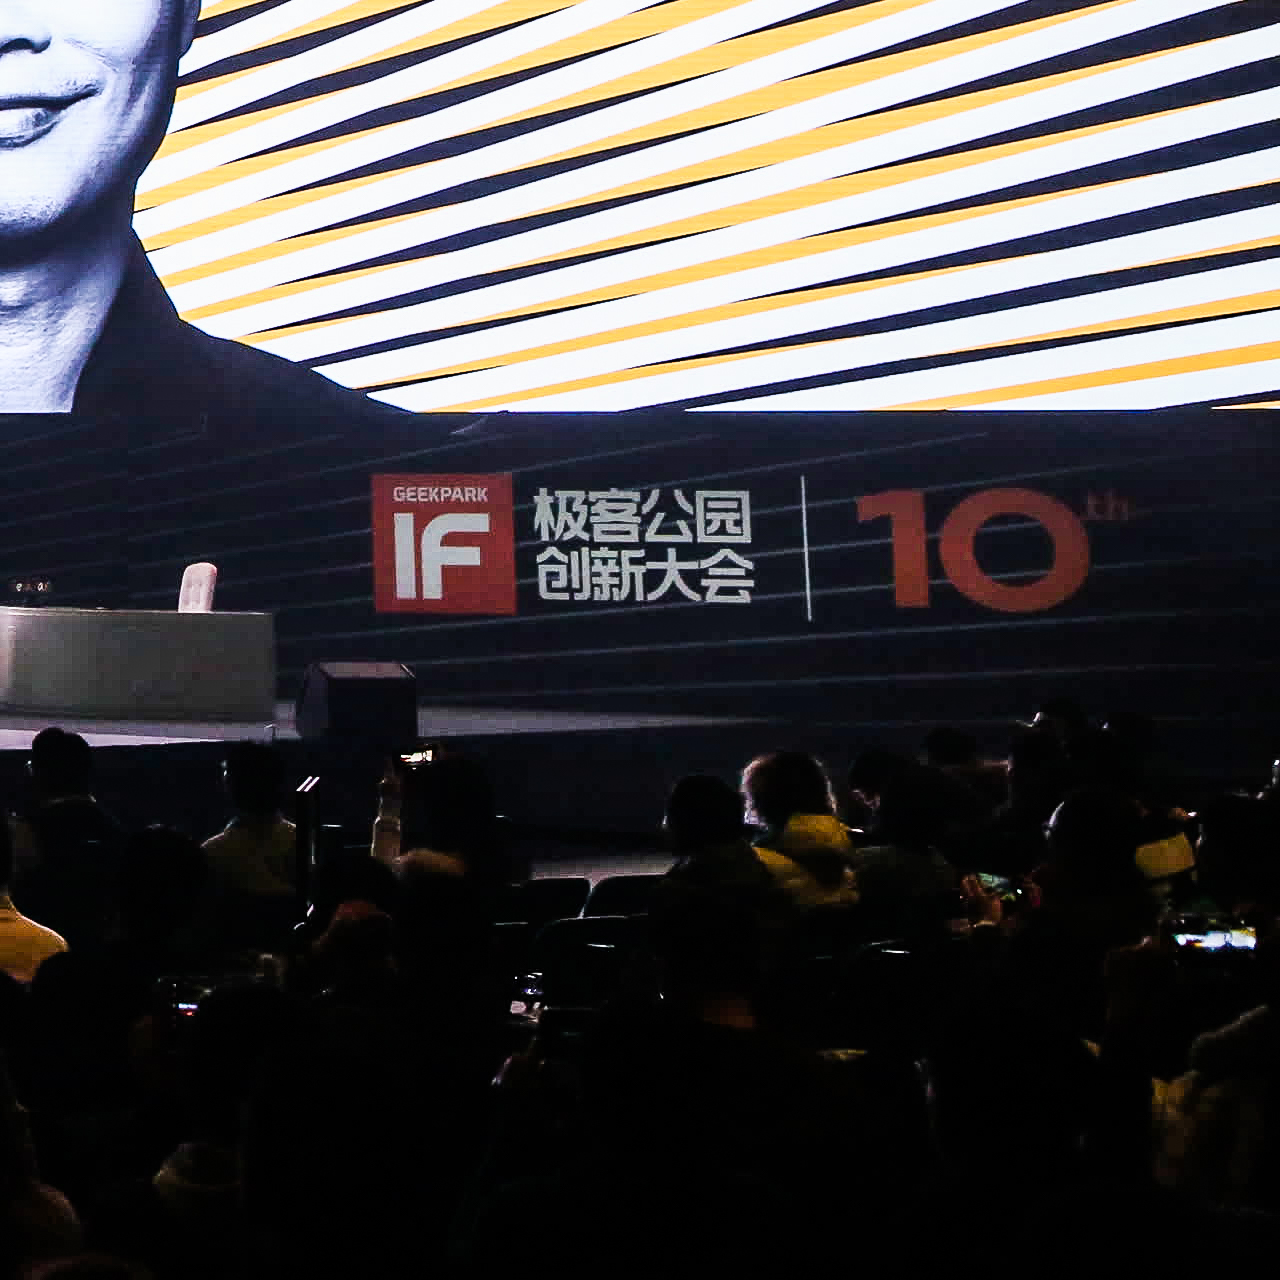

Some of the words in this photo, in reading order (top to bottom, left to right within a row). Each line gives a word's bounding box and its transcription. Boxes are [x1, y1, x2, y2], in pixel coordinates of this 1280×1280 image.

[393, 486, 488, 503] GEEKPARK
[534, 487, 752, 544] 极客公园
[393, 512, 491, 601] IF
[536, 546, 755, 604] 创新大会
